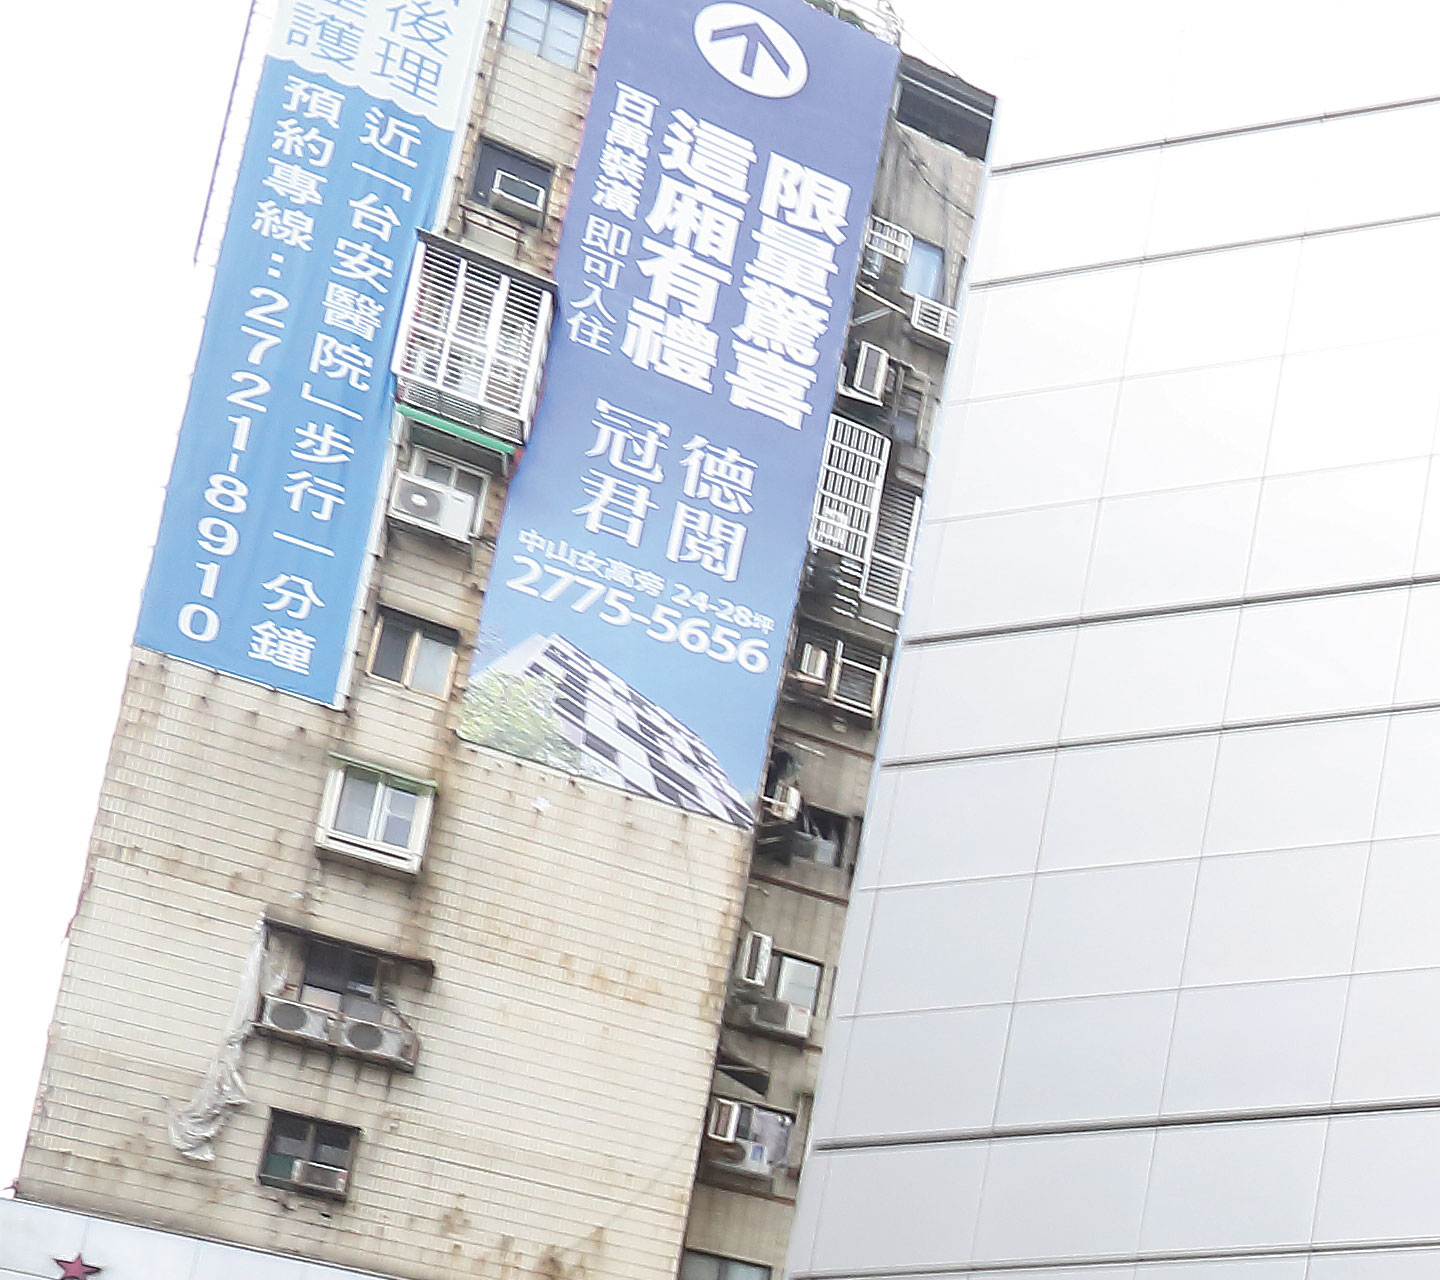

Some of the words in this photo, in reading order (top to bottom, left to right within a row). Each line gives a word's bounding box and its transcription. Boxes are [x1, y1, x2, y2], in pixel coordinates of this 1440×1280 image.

[567, 215, 632, 356] 即可入住
[620, 108, 758, 394] 這廂有禮
[725, 151, 852, 432] 限量驚喜
[505, 555, 770, 675] 2775-5656
